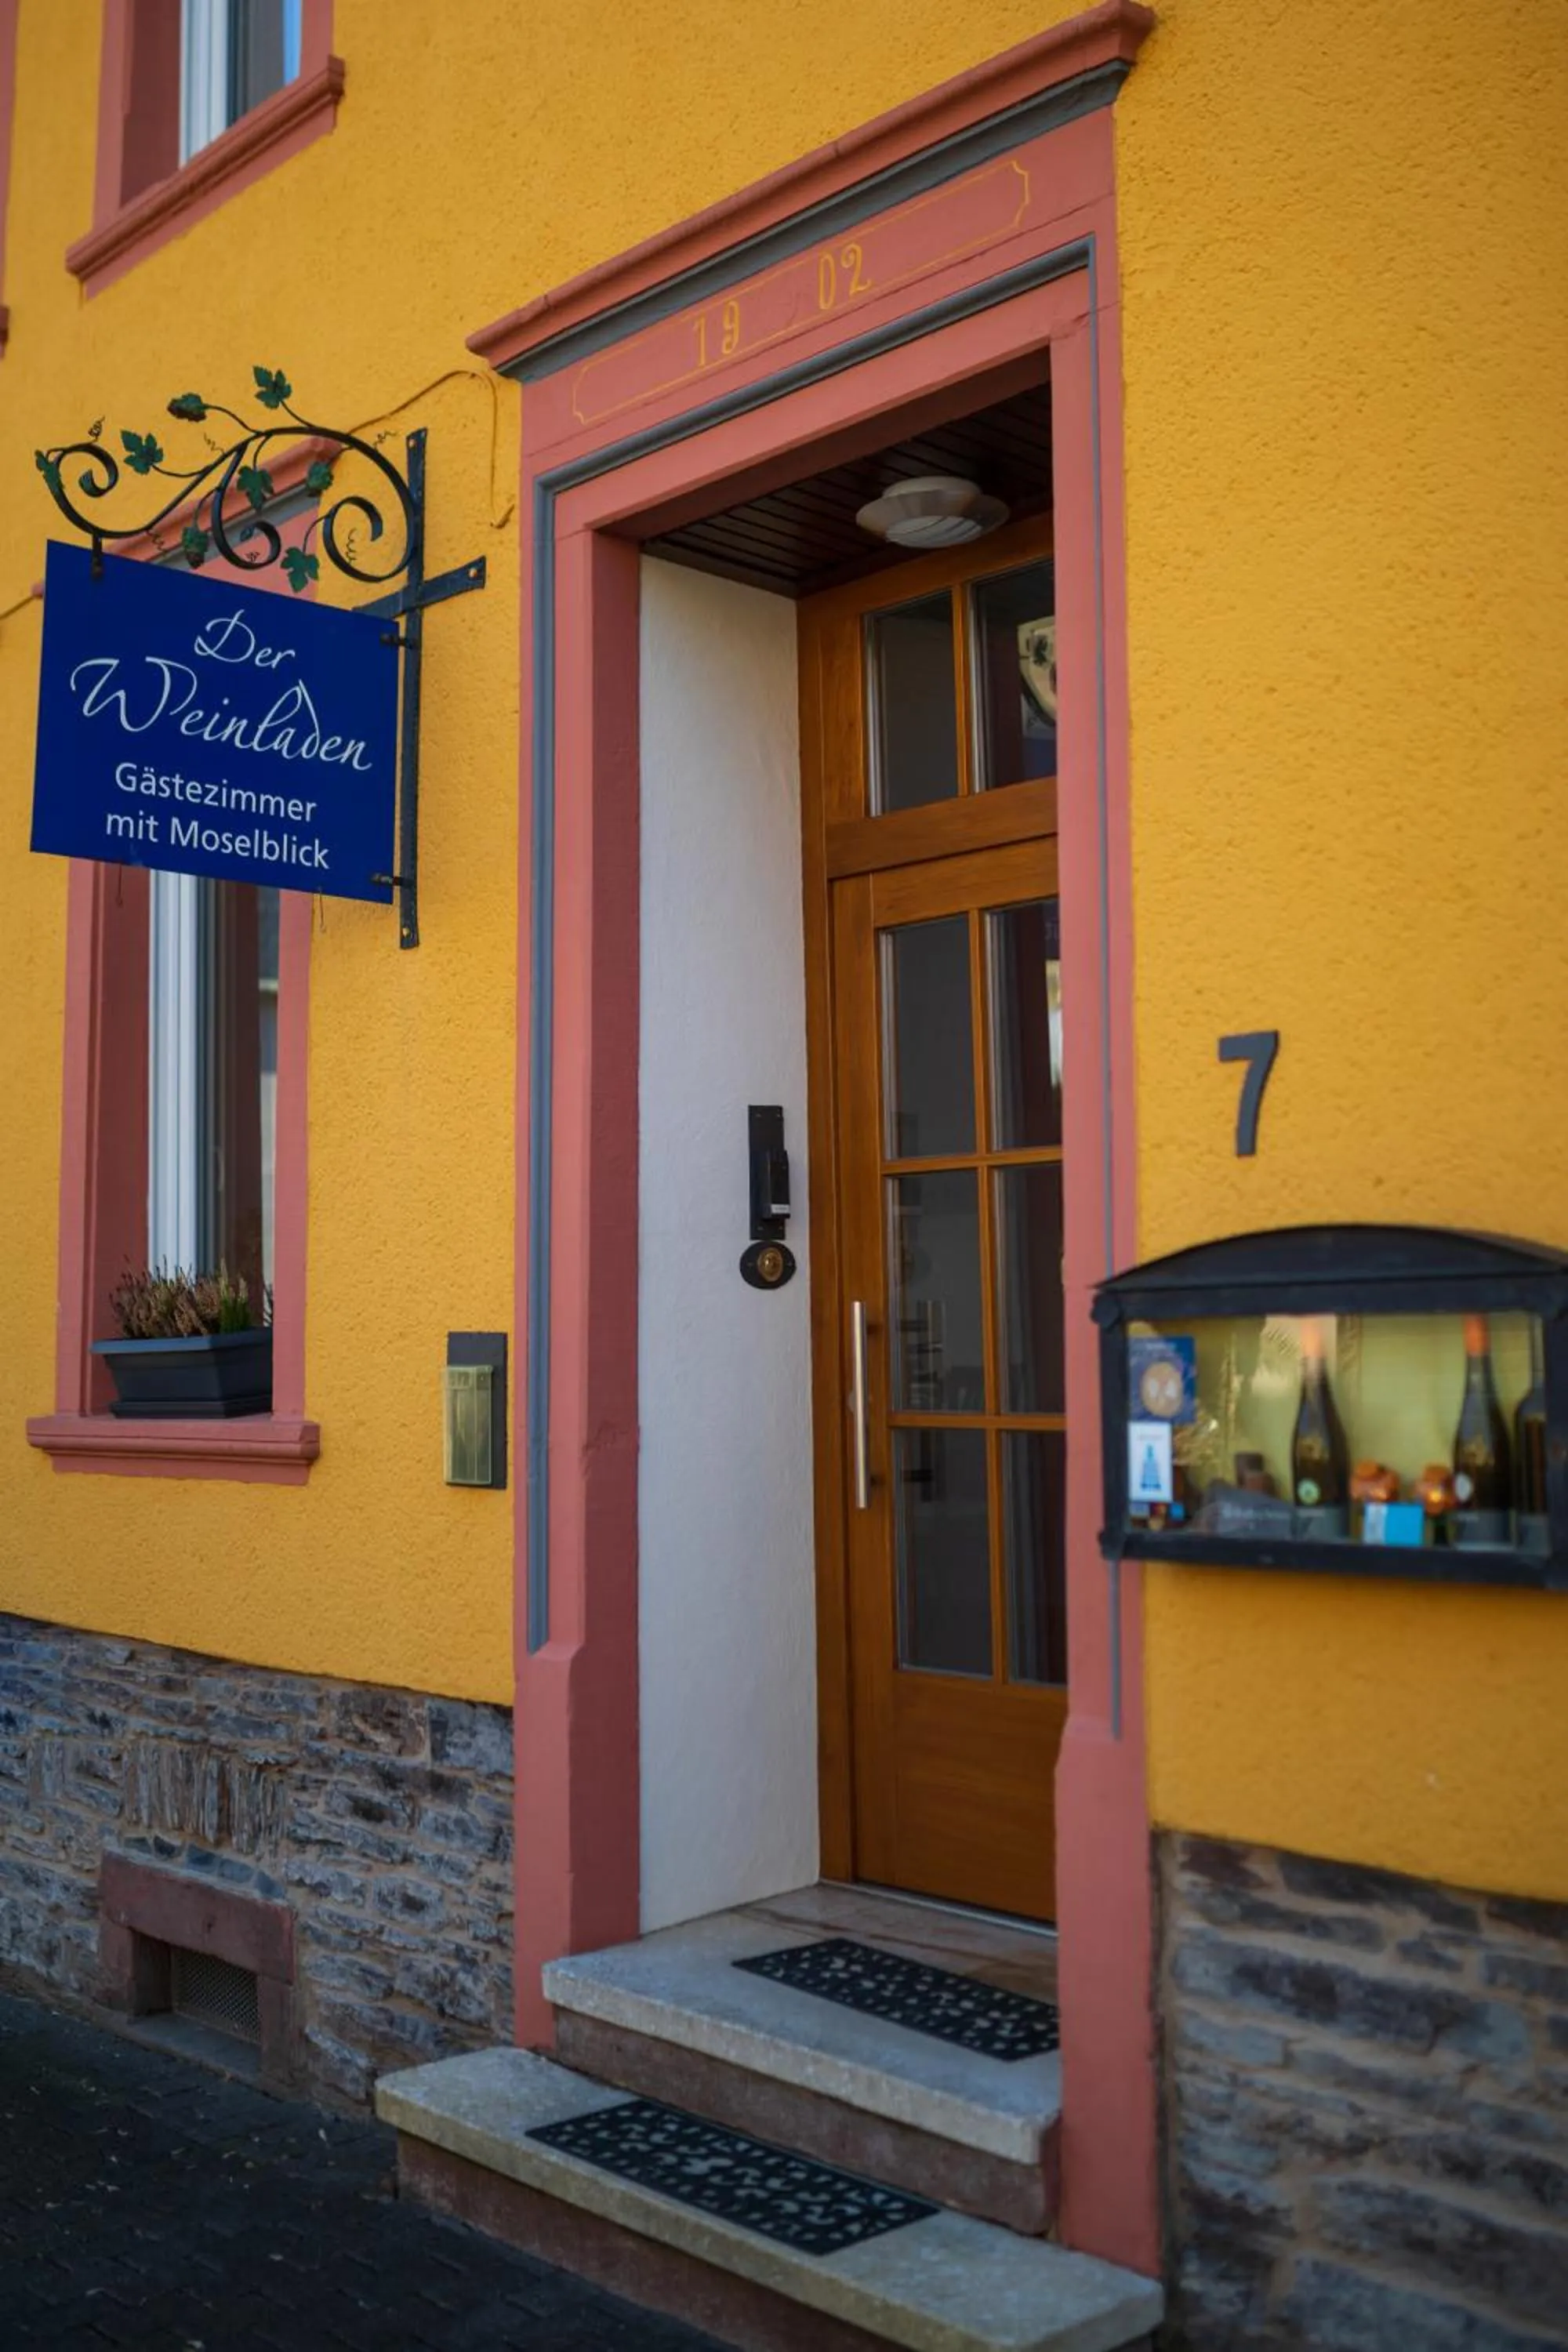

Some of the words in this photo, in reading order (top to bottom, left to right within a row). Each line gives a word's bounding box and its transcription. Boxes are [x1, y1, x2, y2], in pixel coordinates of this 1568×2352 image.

[692, 300, 740, 368] 19
[818, 244, 873, 310] 02
[194, 609, 296, 669] Der
[69, 655, 373, 771] Weinladen
[114, 762, 317, 823] Gästezimmer
[105, 811, 159, 844] mit
[169, 817, 329, 869] Moselblick
[1218, 1029, 1279, 1157] 7
